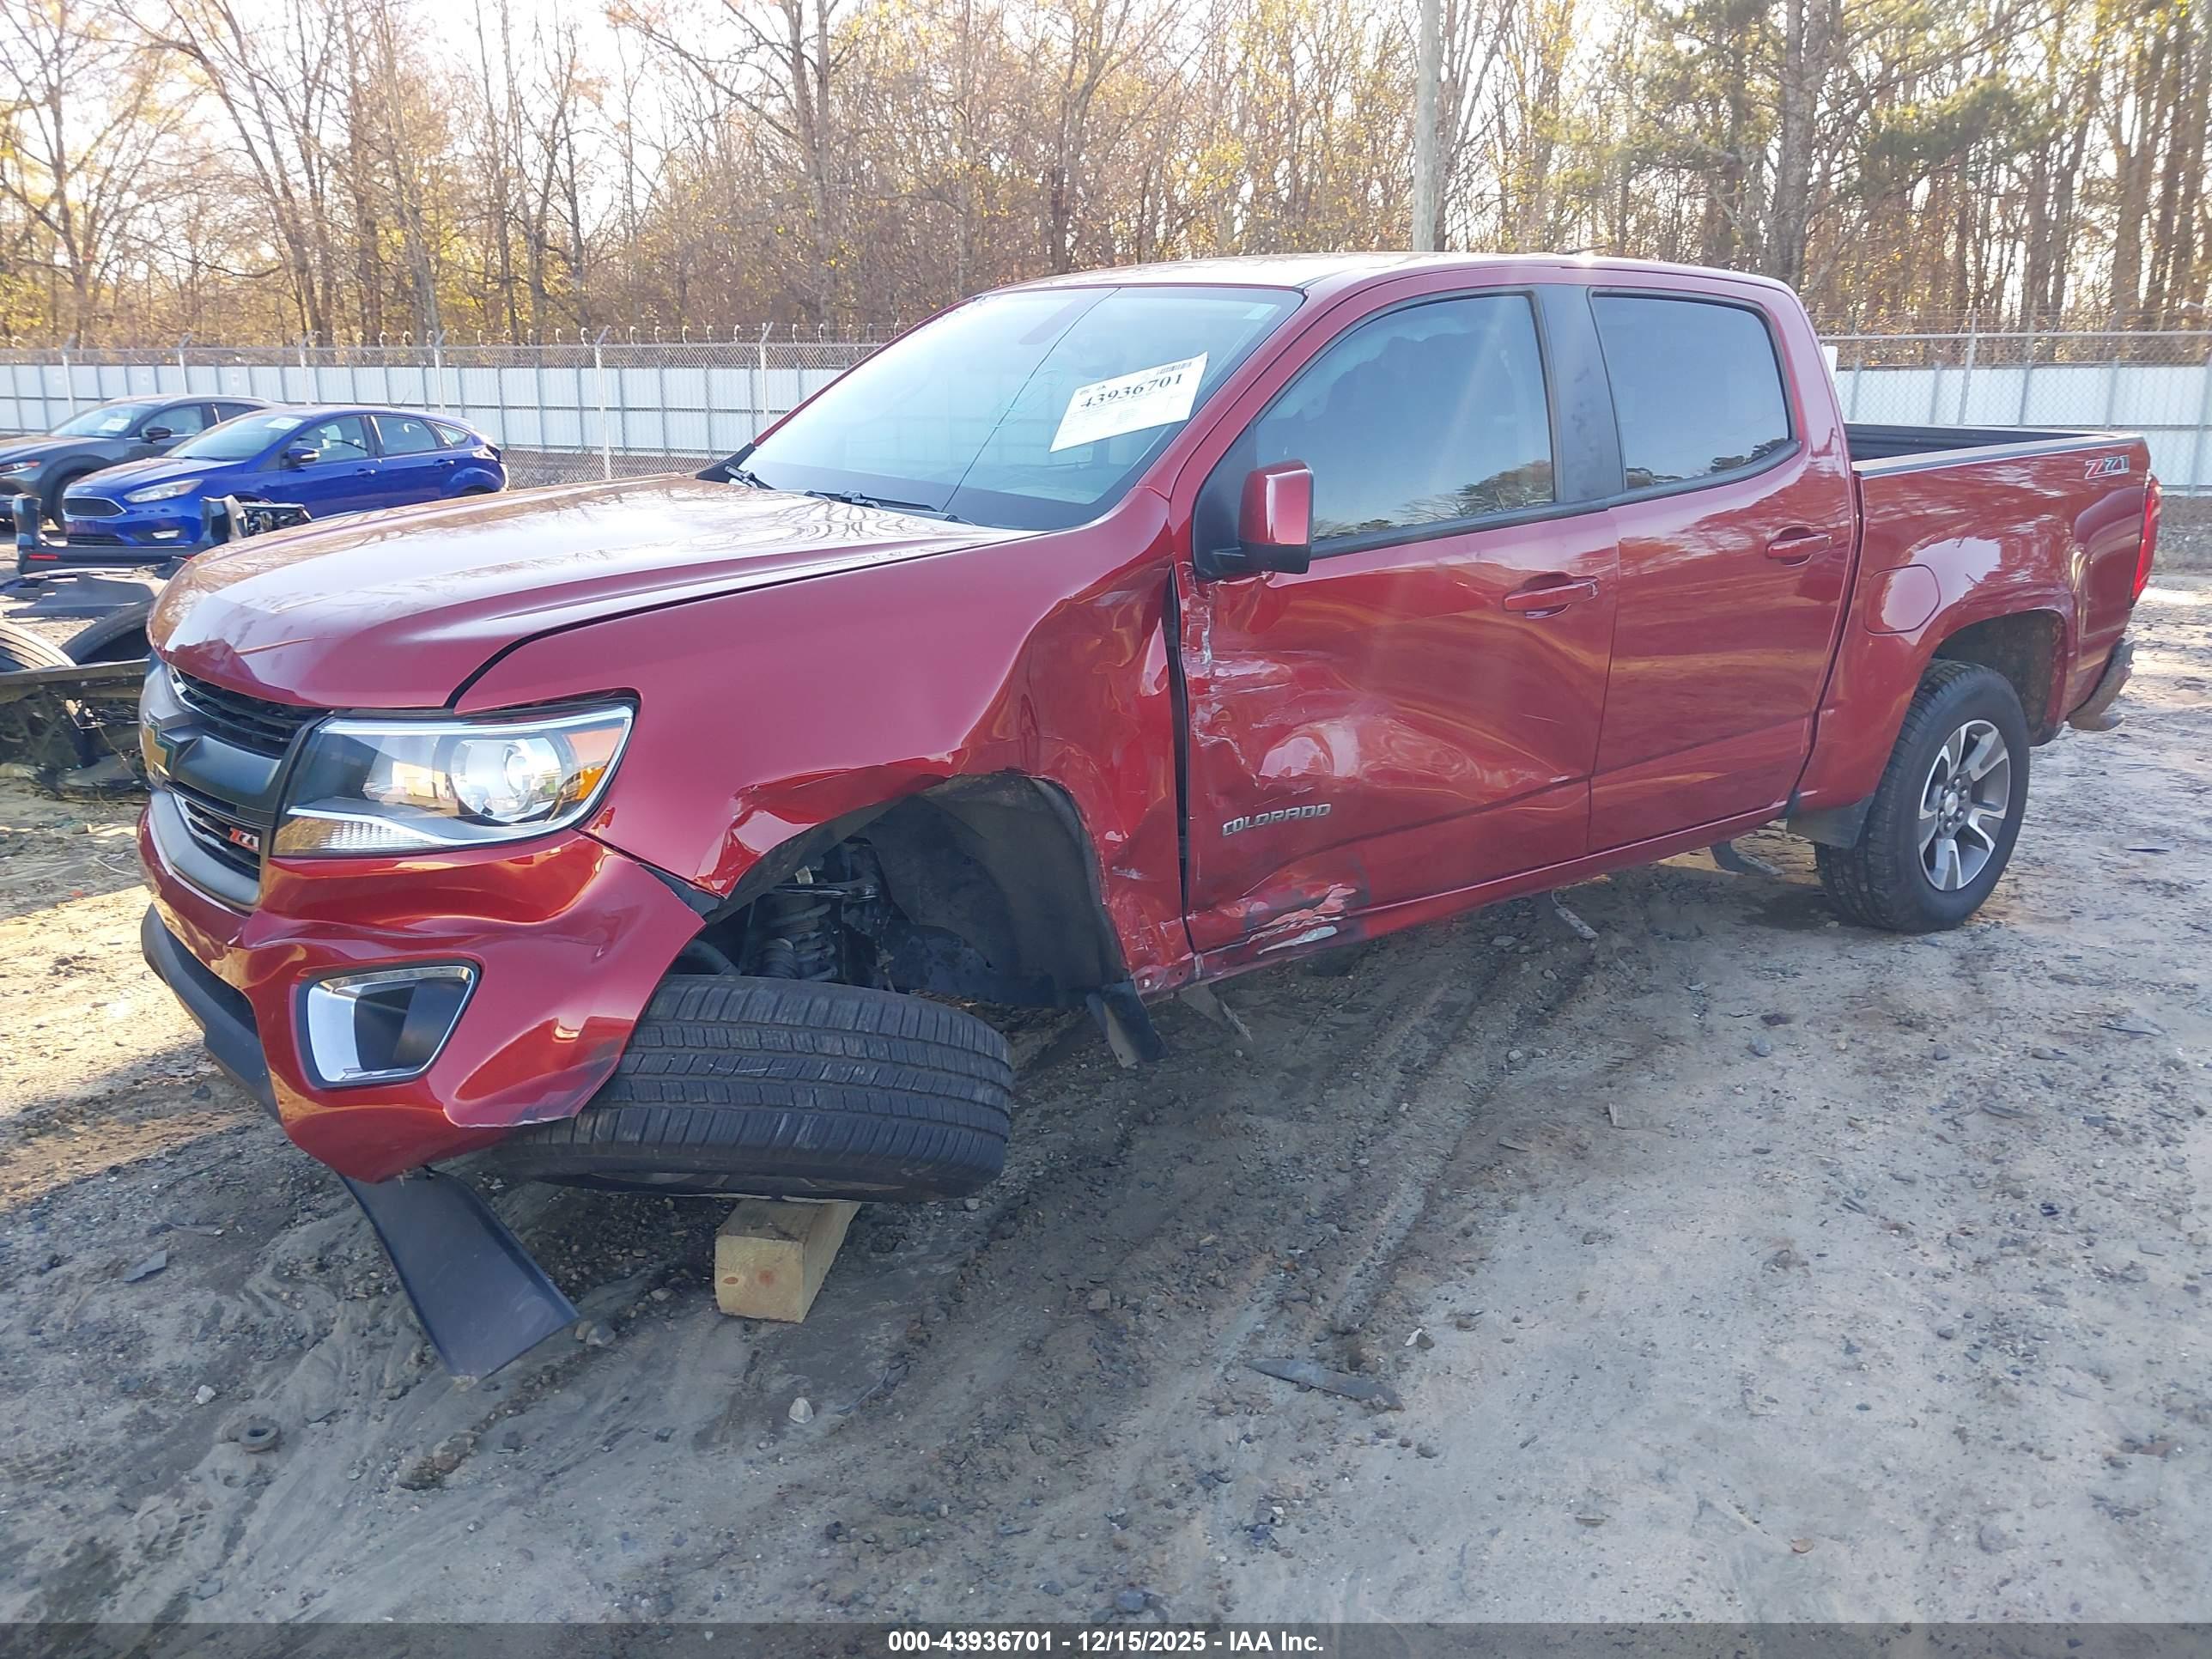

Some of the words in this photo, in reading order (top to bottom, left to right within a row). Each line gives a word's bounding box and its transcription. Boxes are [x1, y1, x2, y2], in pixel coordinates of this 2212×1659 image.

[1079, 373, 1183, 408] 43936701
[2084, 454, 2130, 480] Z71
[1222, 803, 1332, 837] COLORADO
